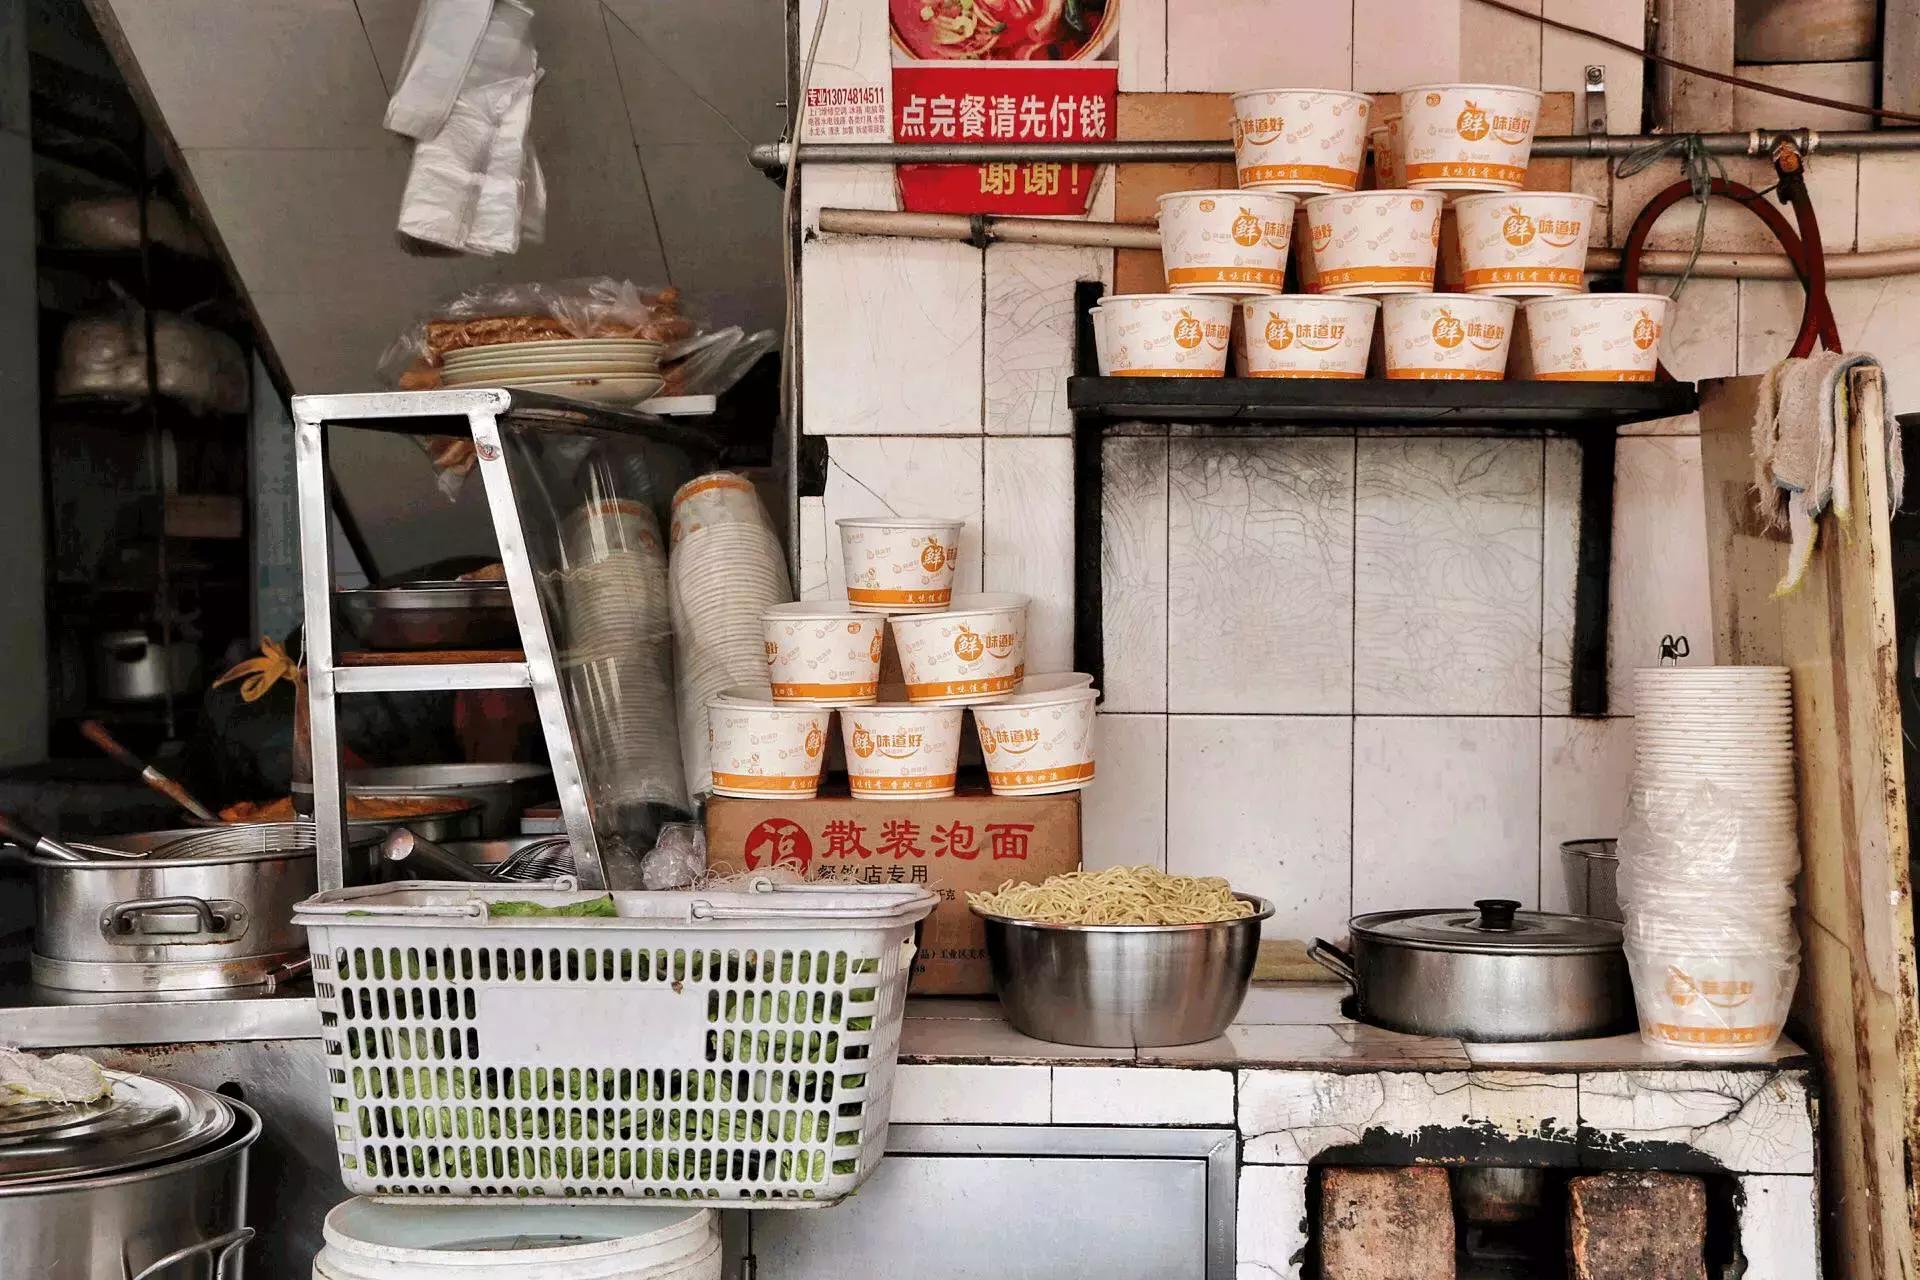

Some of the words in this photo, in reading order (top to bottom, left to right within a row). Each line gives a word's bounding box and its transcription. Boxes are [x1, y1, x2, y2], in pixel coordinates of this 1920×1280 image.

[900, 94, 1106, 138] 点完餐请先付钱
[1538, 219, 1581, 236] 味道好
[1205, 323, 1229, 339] 味道
[1296, 324, 1345, 339] 味道好
[877, 734, 923, 748] 味道好
[996, 727, 1041, 743] 味道好
[821, 819, 1035, 861] 散装泡面
